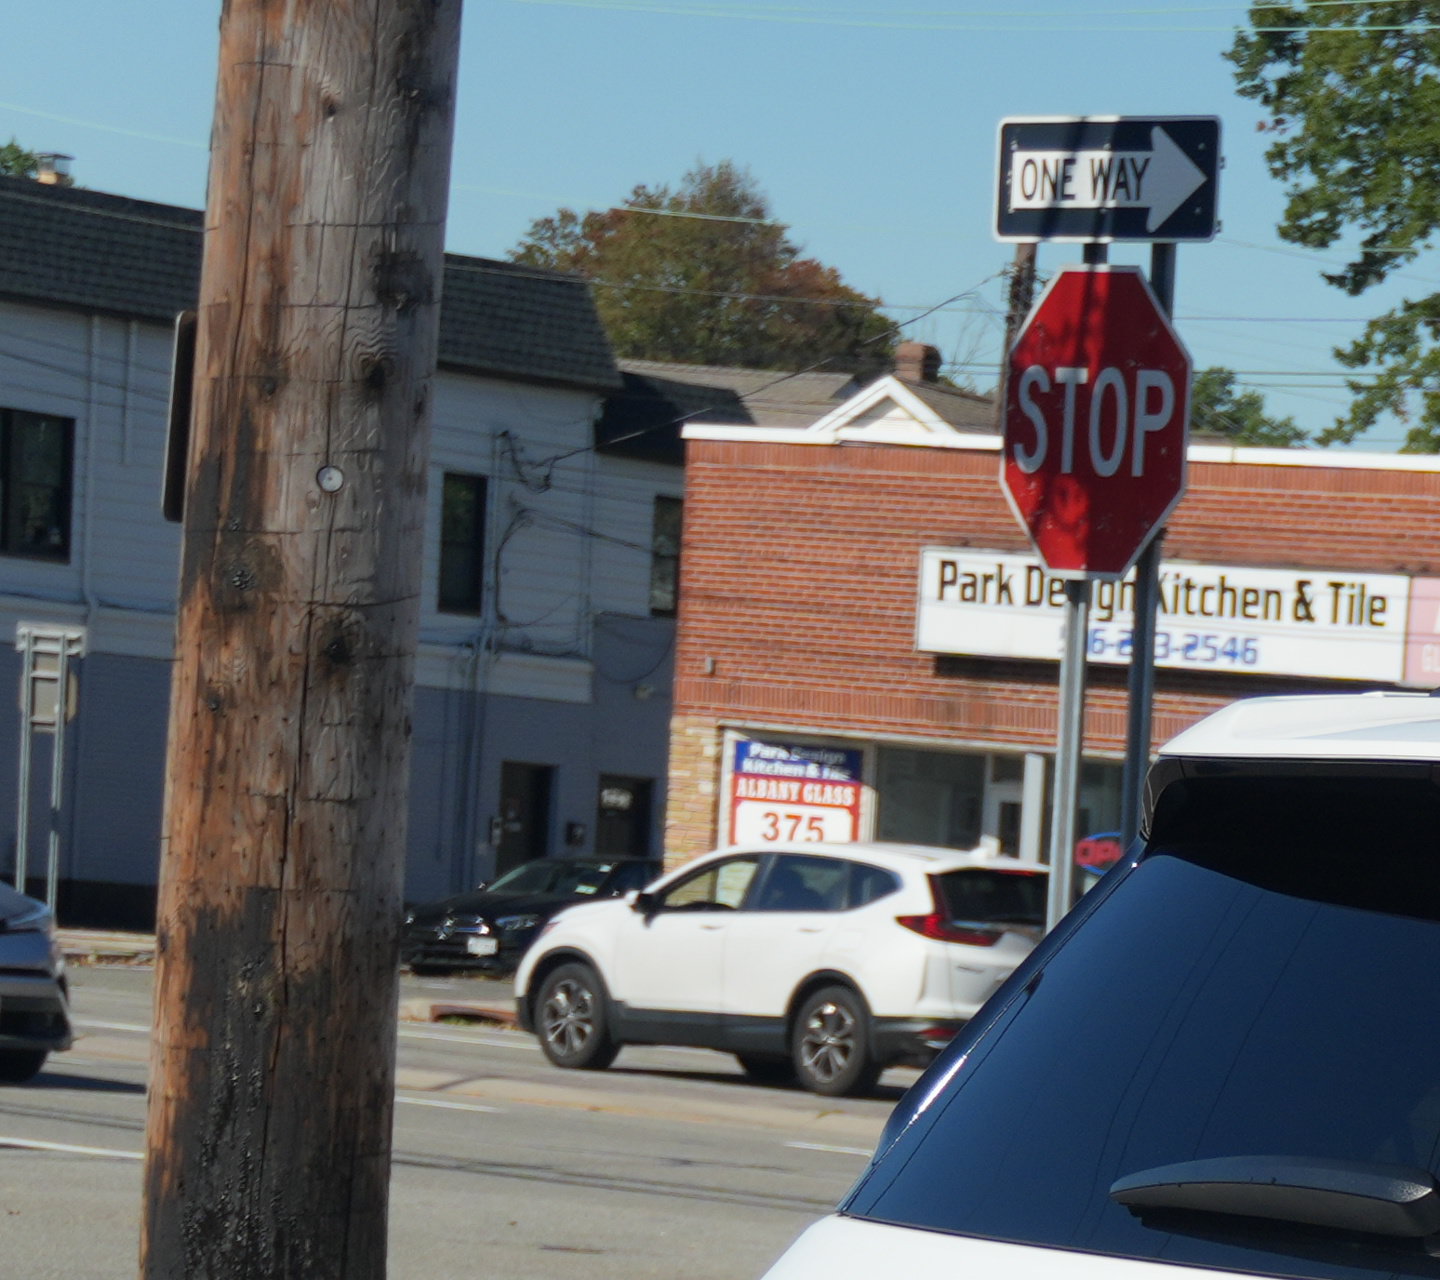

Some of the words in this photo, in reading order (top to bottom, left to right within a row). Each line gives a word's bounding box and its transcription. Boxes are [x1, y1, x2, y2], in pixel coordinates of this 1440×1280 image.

[1021, 158, 1076, 200] ONE
[1089, 157, 1150, 201] WAY
[1014, 364, 1175, 477] STOP
[938, 560, 1013, 604] Park
[1292, 580, 1316, 623] &
[1328, 581, 1388, 627] Tile
[736, 777, 802, 801] ALBANY
[803, 783, 855, 807] GLASS
[762, 812, 825, 842] 375
